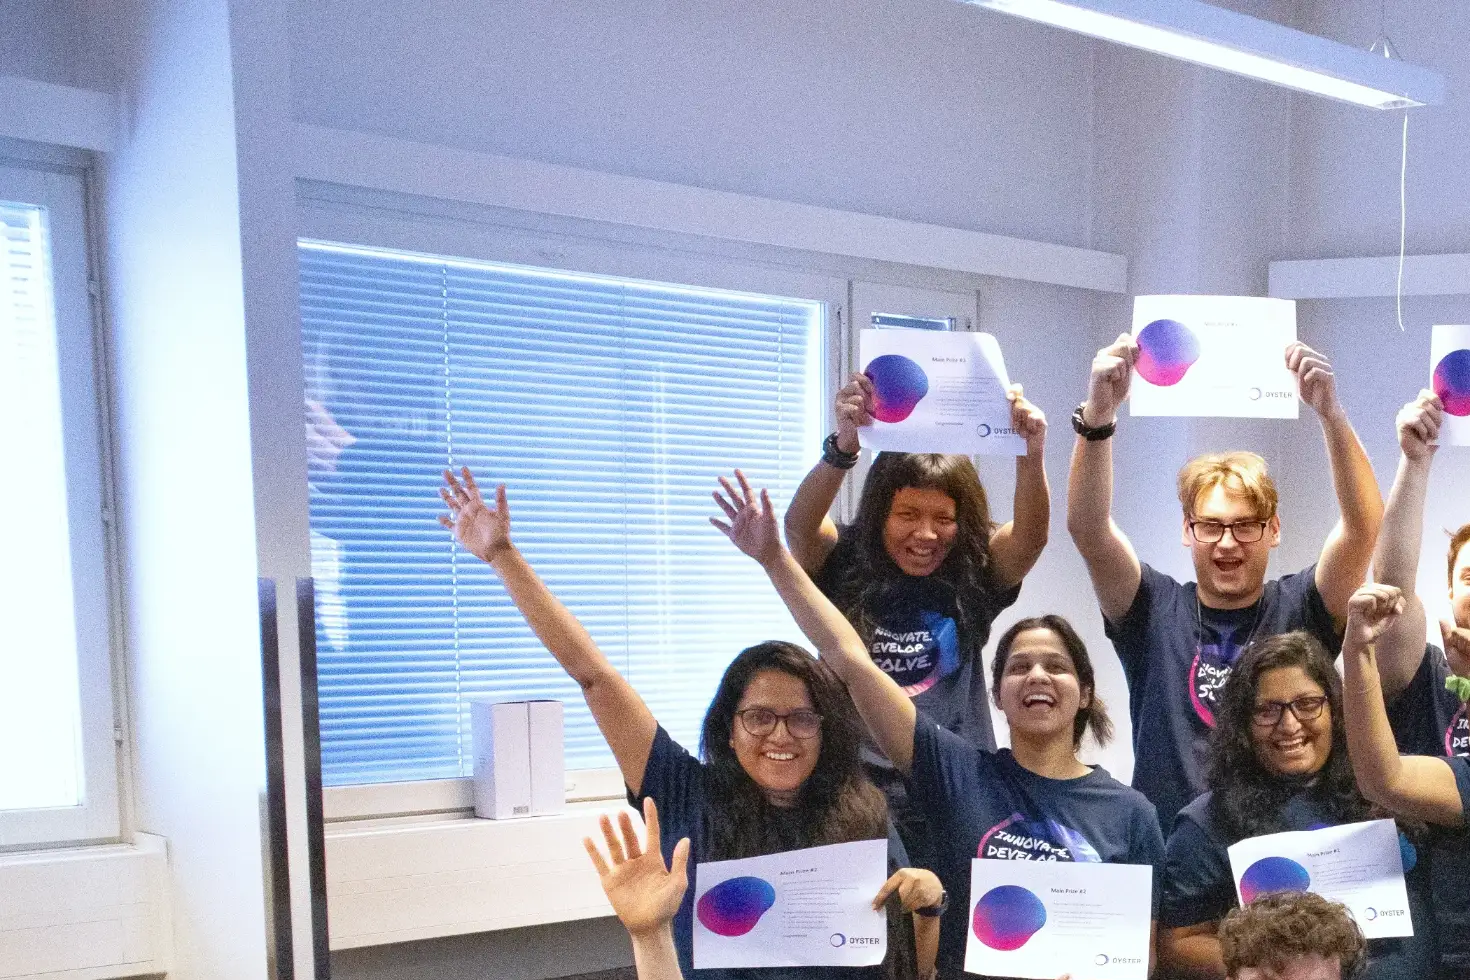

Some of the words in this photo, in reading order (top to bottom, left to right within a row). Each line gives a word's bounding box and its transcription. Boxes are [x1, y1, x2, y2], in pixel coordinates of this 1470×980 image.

[1265, 390, 1293, 399] OYSTER
[1380, 909, 1405, 918] OYSTER
[849, 936, 880, 946] OYSTER
[1112, 956, 1142, 965] OYSTER
